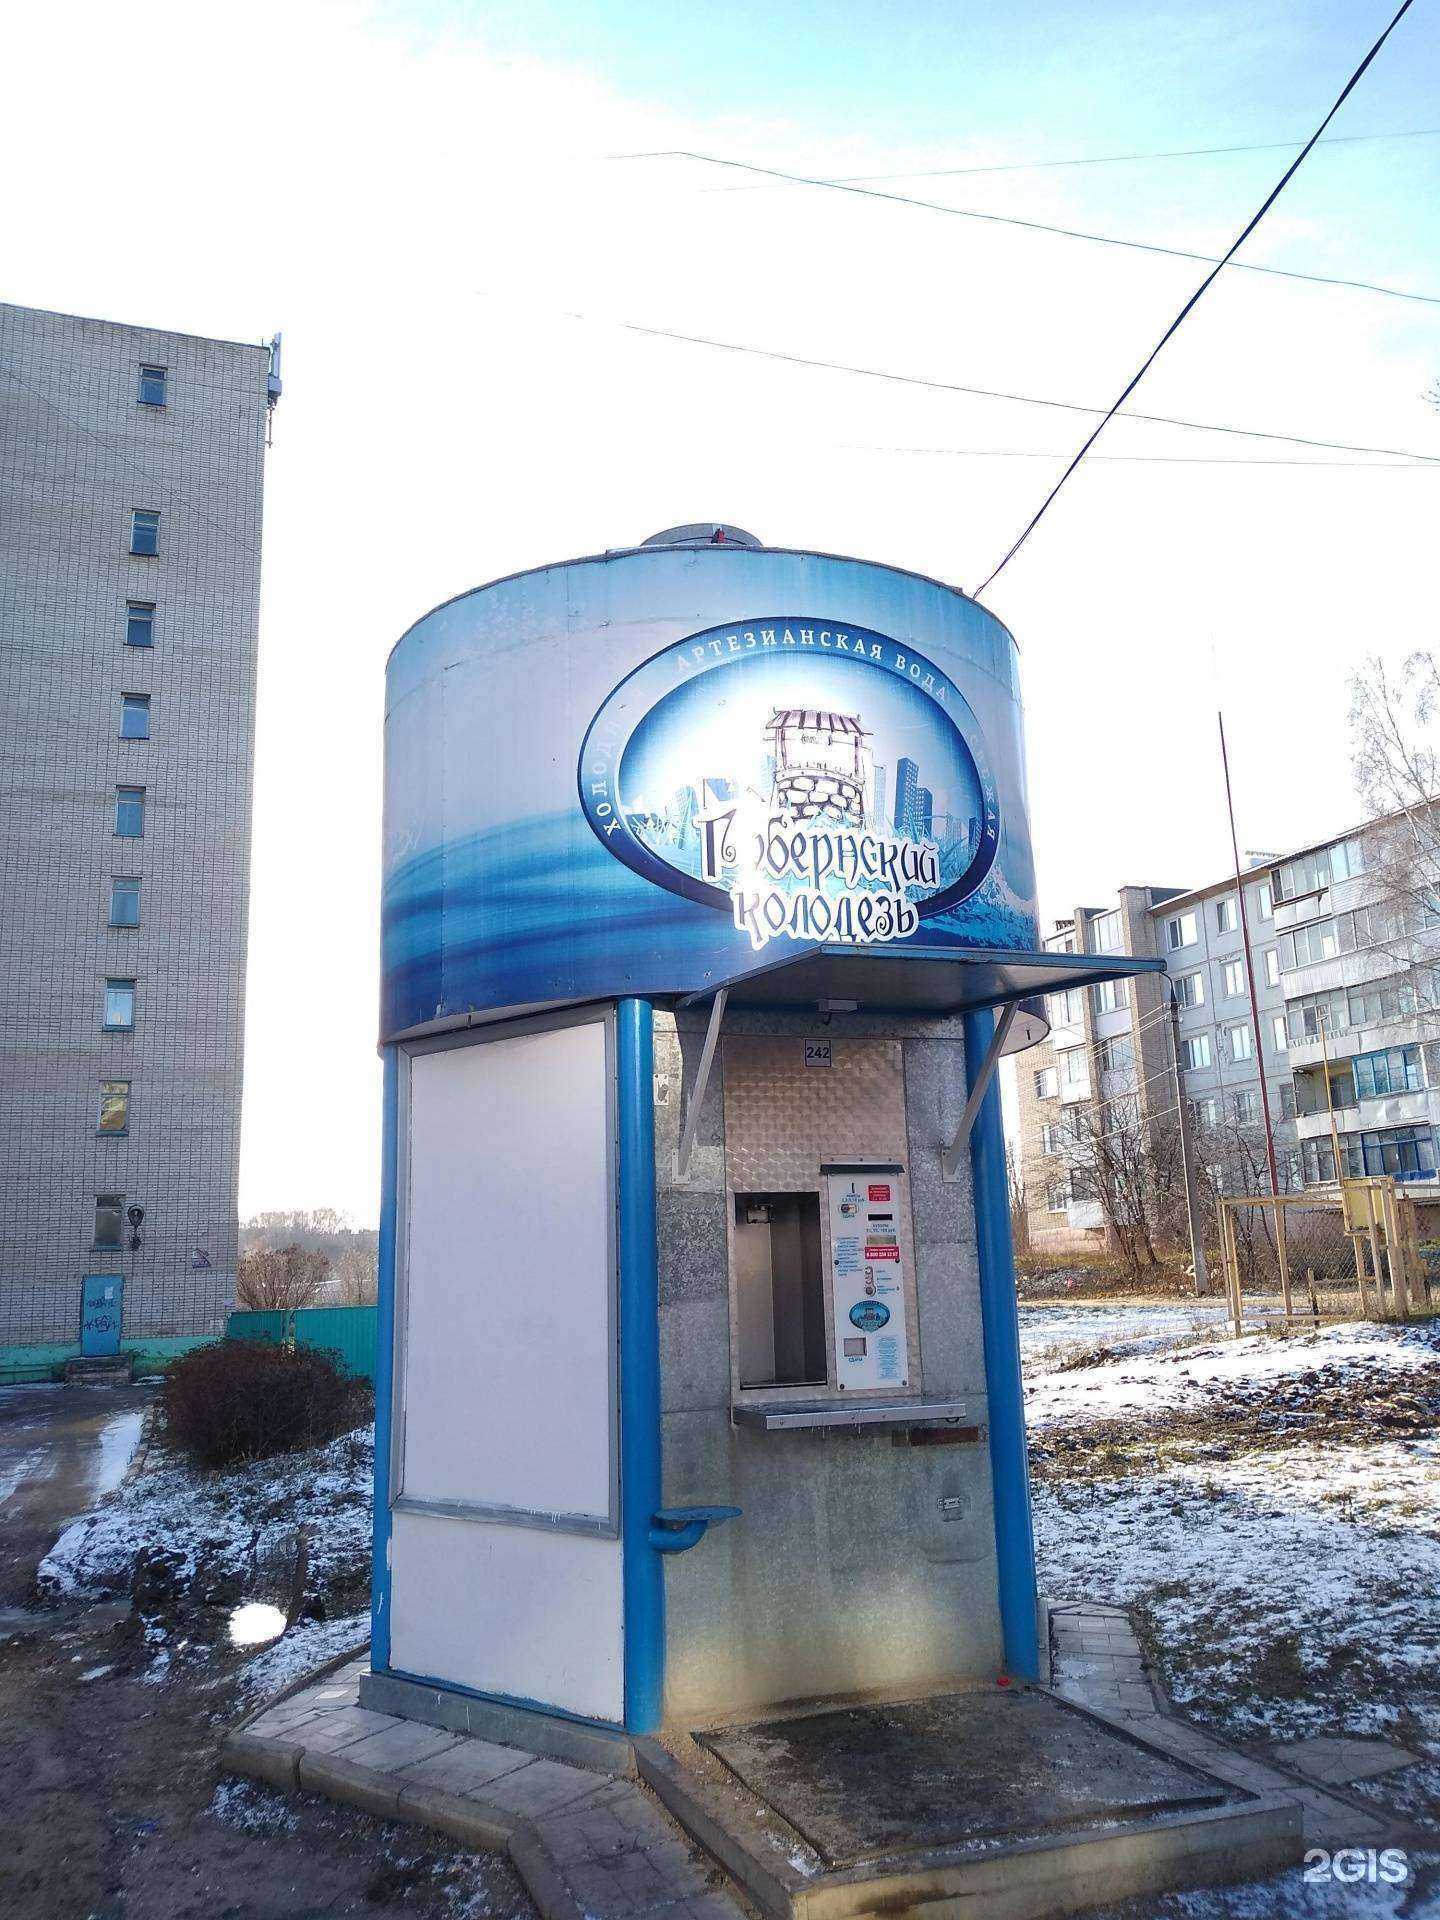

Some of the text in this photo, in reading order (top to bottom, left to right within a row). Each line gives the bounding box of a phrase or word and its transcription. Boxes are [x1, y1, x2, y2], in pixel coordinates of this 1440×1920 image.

[677, 628, 882, 672] АРТЕЗИАНСКАЯ
[894, 654, 947, 700] ВОДА
[806, 1046, 830, 1059] 242
